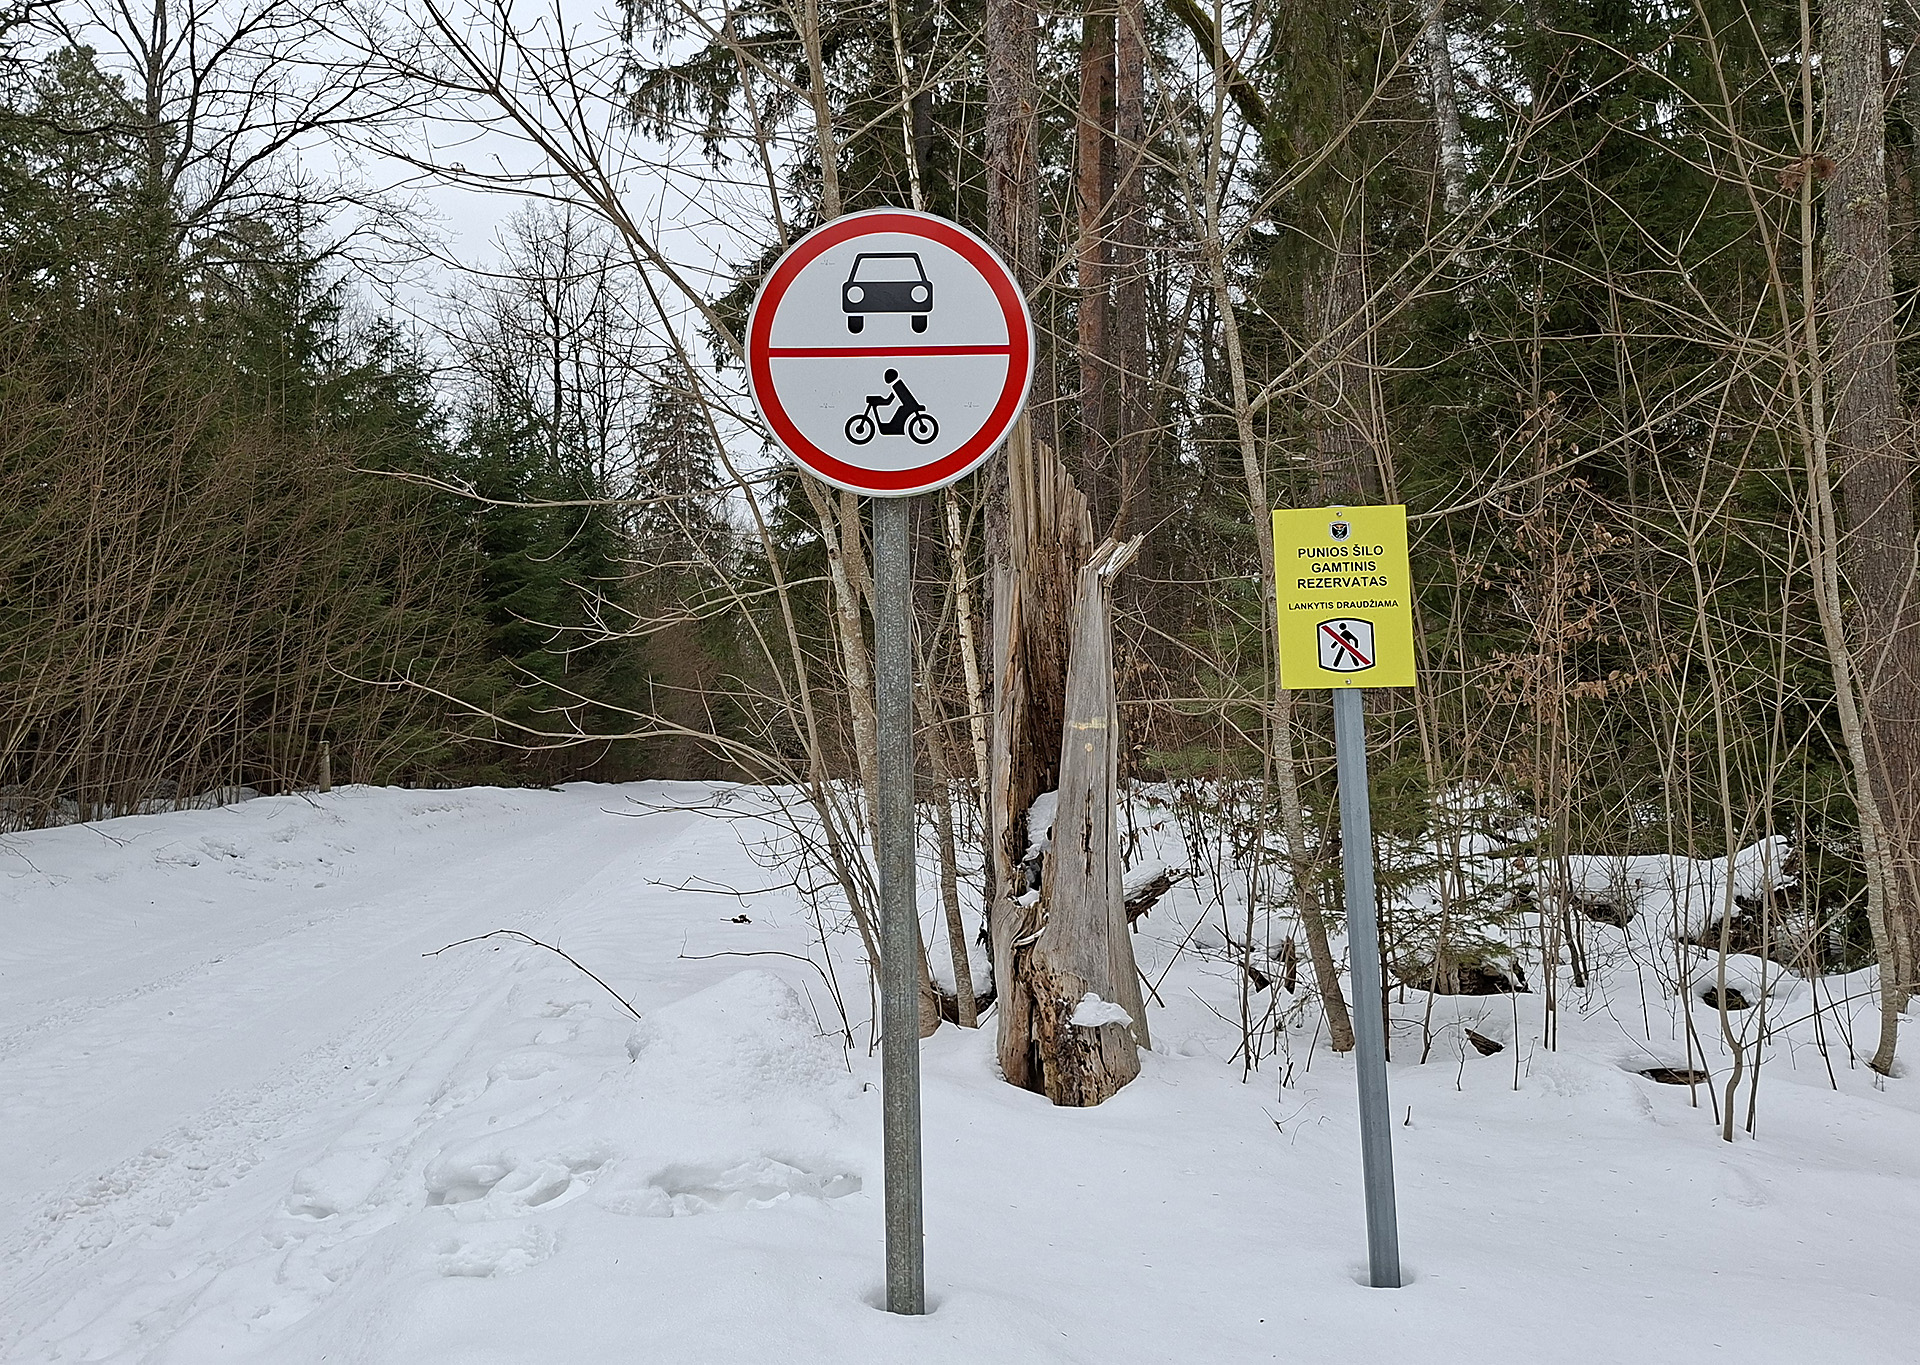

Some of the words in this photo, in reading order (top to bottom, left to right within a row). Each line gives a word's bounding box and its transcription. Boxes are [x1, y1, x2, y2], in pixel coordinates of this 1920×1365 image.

[1298, 546, 1348, 558] PUNIOS
[1352, 544, 1383, 556] ŠILO
[1311, 561, 1376, 573] GAMTINIS
[1297, 576, 1387, 589] REZERVATAS
[1288, 601, 1334, 610] LANKYTIS
[1336, 599, 1398, 609] DRAUDŽIAMA
